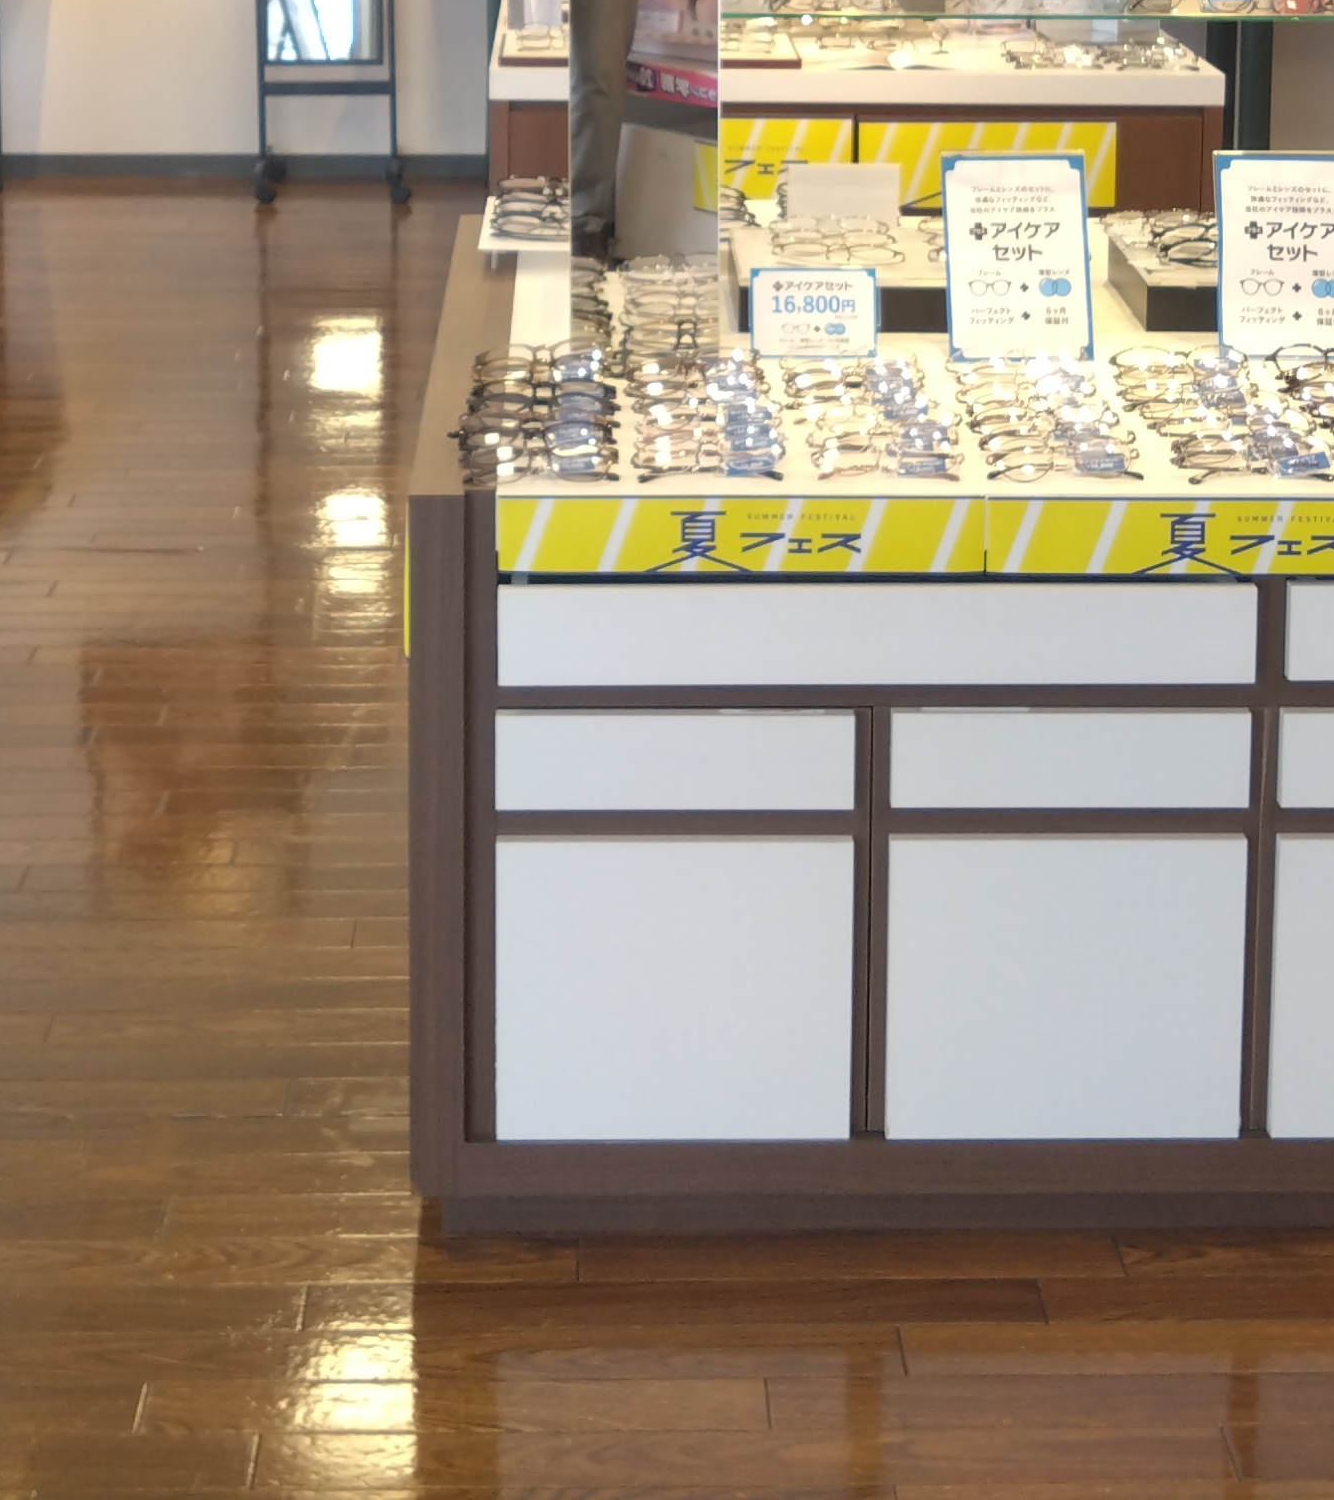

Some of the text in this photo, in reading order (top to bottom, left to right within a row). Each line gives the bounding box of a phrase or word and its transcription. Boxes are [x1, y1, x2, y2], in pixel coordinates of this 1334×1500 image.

[990, 221, 1060, 240] アイケア
[992, 244, 1043, 262] セット
[1266, 243, 1318, 262] セット
[771, 295, 856, 314] 16,800円
[1236, 514, 1284, 523] SUMMER
[644, 510, 862, 573] 夏フェス
